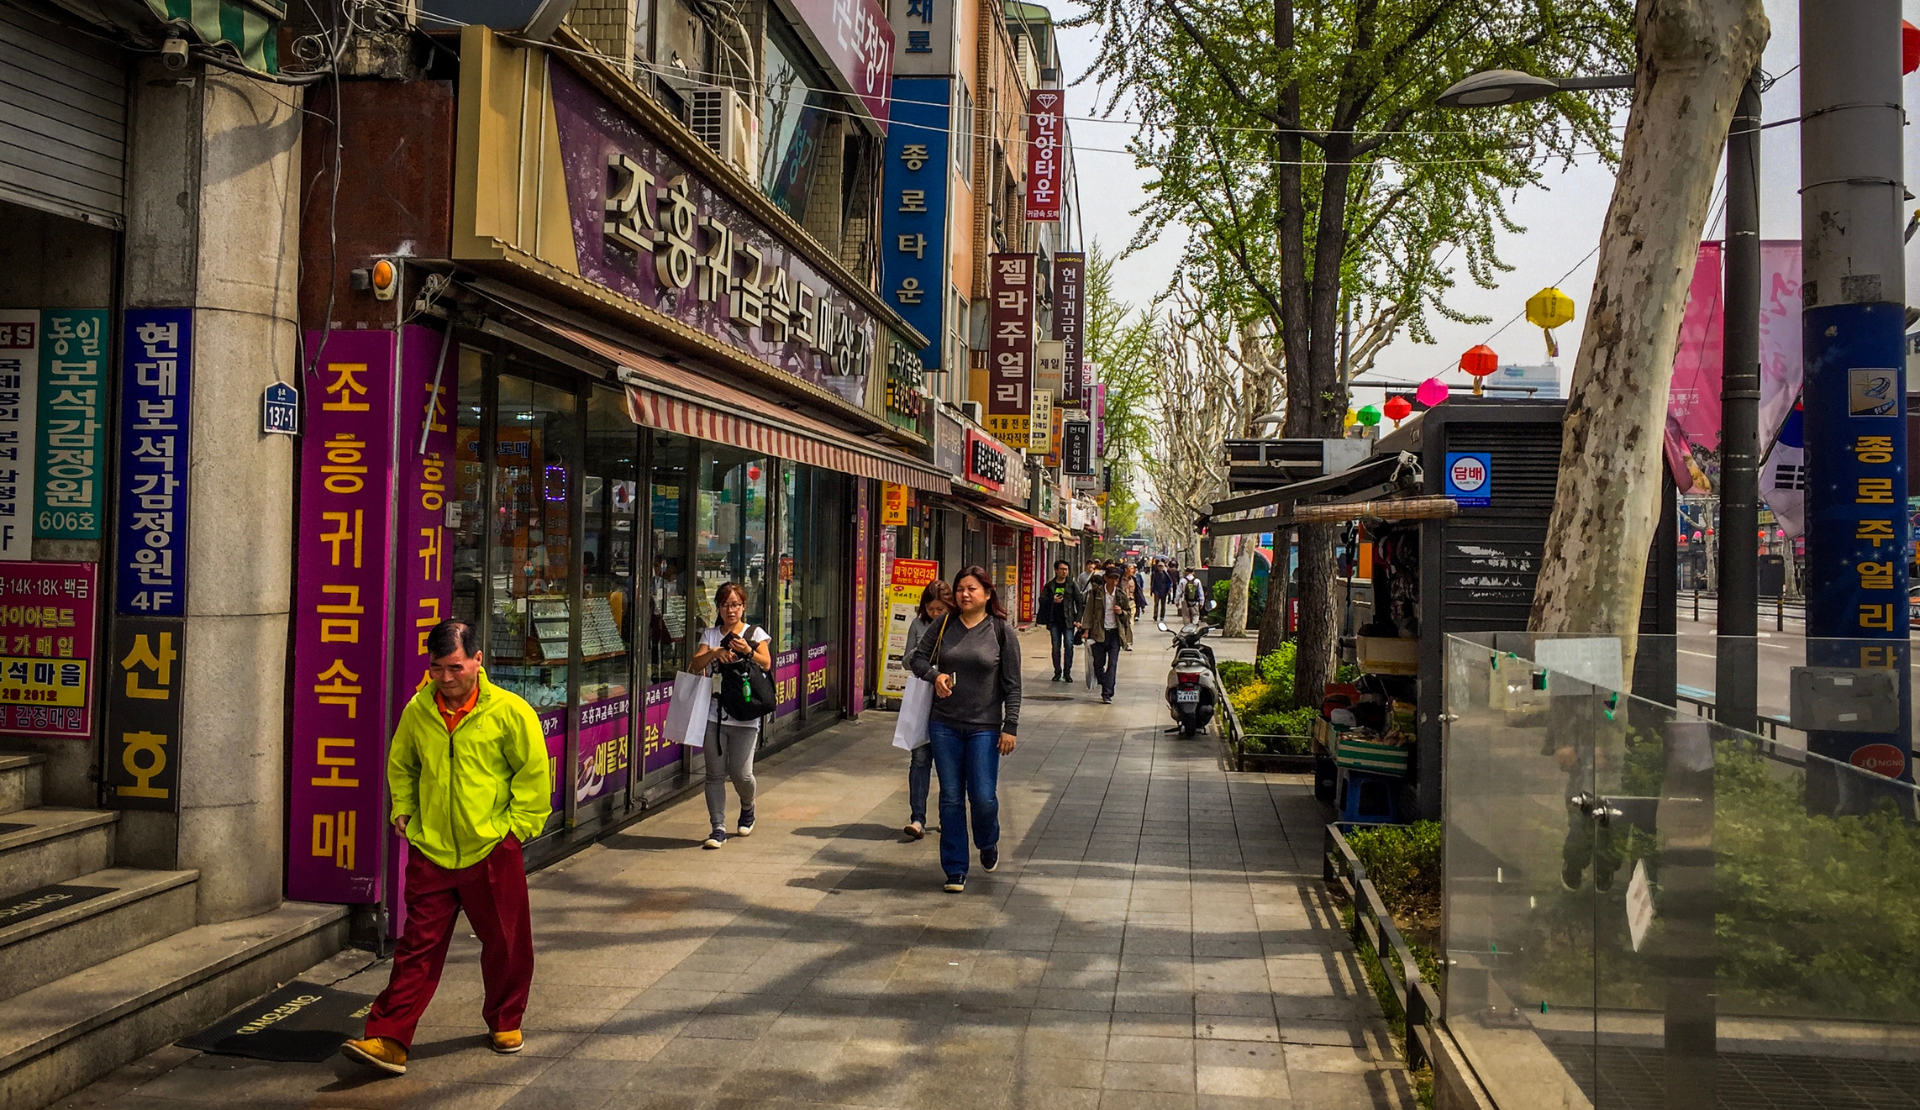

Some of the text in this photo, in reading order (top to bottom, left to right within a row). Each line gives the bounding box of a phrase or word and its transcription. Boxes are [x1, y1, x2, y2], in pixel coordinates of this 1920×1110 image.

[1033, 112, 1057, 202] 한양타운
[896, 144, 929, 303] 종로타운
[603, 153, 869, 377] 조흥귀금속도매상가
[47, 317, 100, 356] 동일
[996, 259, 1028, 409] 젤라주얼리
[1040, 358, 1060, 370] 제일
[1060, 267, 1077, 397] 현대귀금속프라자
[44, 360, 101, 508] 보석감정원
[269, 406, 293, 427] 137-1
[990, 418, 1030, 430] 예물전문
[130, 320, 180, 585] 현대보석감정원
[1454, 466, 1483, 481] 담배
[39, 511, 95, 531] 606호
[415, 383, 447, 692] 조흥귀금
[1855, 435, 1896, 669] 종로주얼리타
[0, 577, 89, 599] ·14K·18K·백금
[130, 591, 173, 611] 4F
[311, 362, 369, 870] 조흥귀금속도매
[0, 661, 81, 687] 석마을
[16, 706, 82, 730] 감정매입
[117, 631, 177, 799] 산호
[1860, 757, 1904, 769] JONGNO
